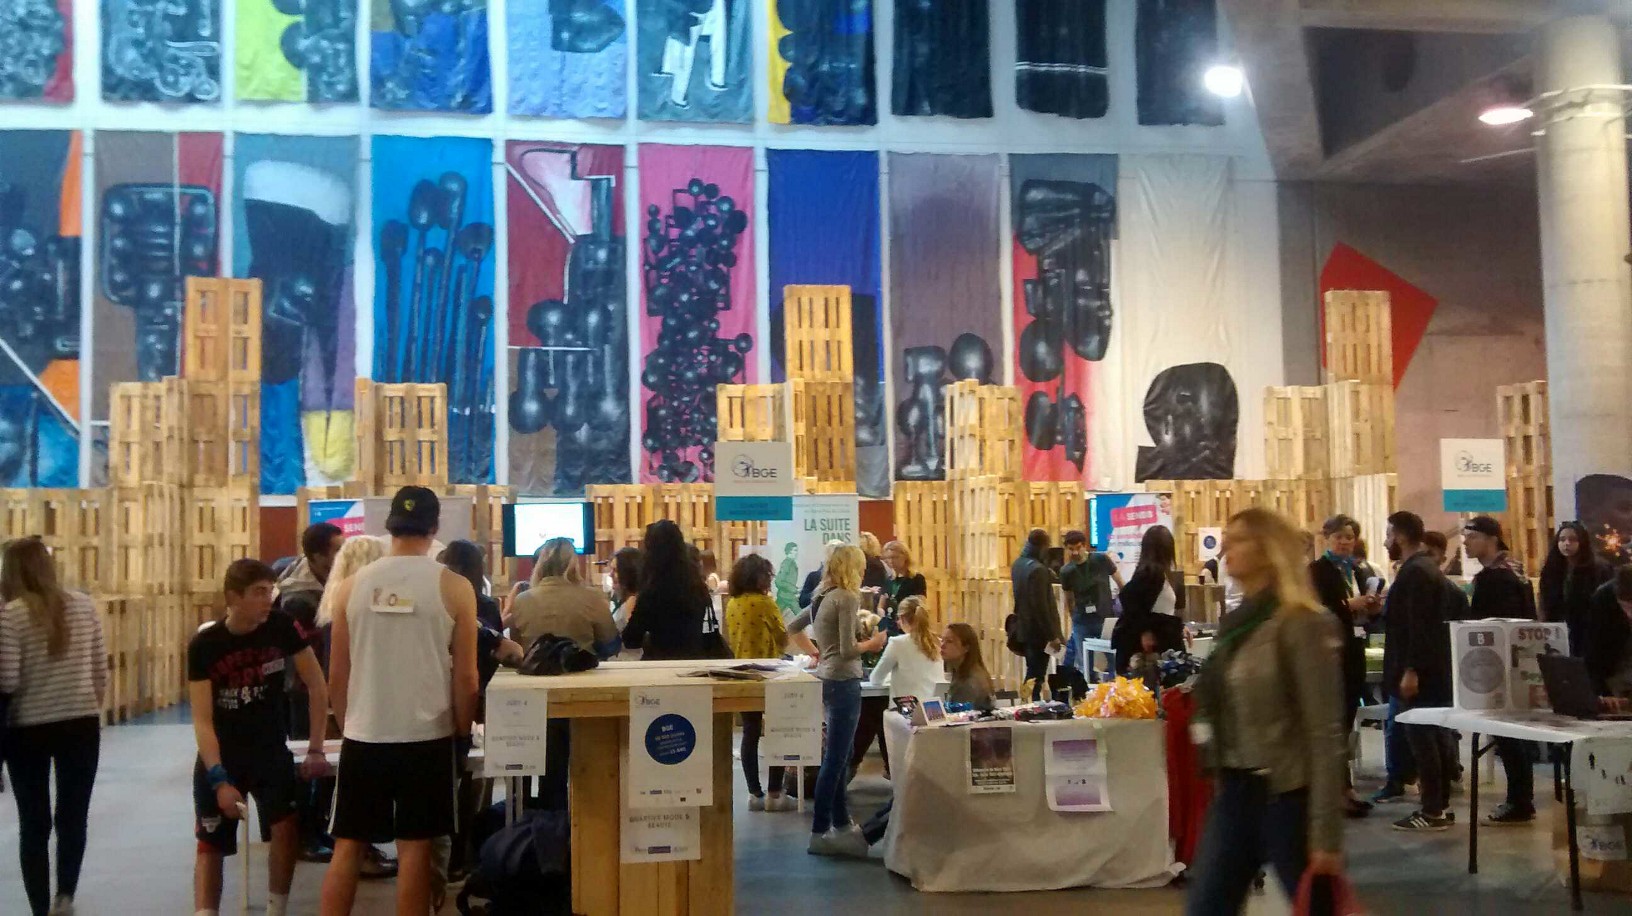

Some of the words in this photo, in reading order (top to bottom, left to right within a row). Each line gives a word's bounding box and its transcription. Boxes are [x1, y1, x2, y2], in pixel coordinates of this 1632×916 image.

[752, 468, 777, 478] BGE
[1472, 463, 1492, 473] BGE
[804, 518, 818, 531] LA
[820, 518, 851, 531] SUITE
[822, 532, 851, 545] DANS
[1518, 627, 1551, 641] STOP
